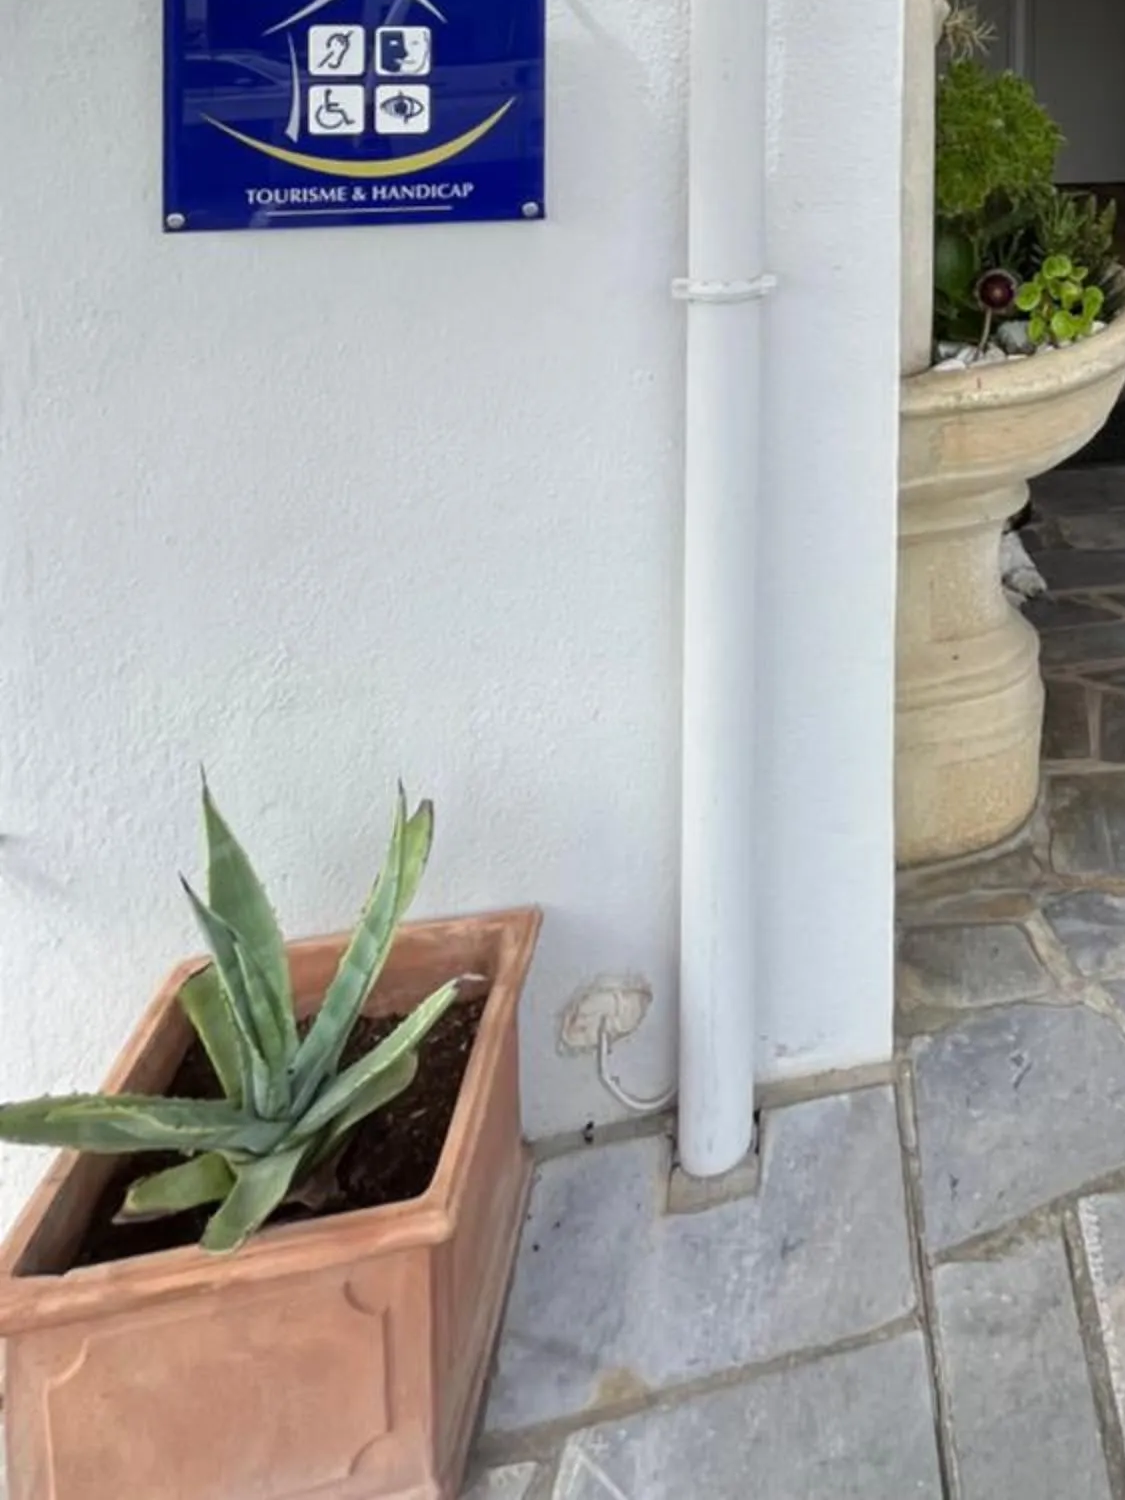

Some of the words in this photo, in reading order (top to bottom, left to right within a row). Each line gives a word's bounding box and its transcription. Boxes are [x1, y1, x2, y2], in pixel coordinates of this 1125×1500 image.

[246, 187, 347, 204] TOURISME
[351, 186, 366, 202] &
[371, 182, 475, 200] HANDICAP
